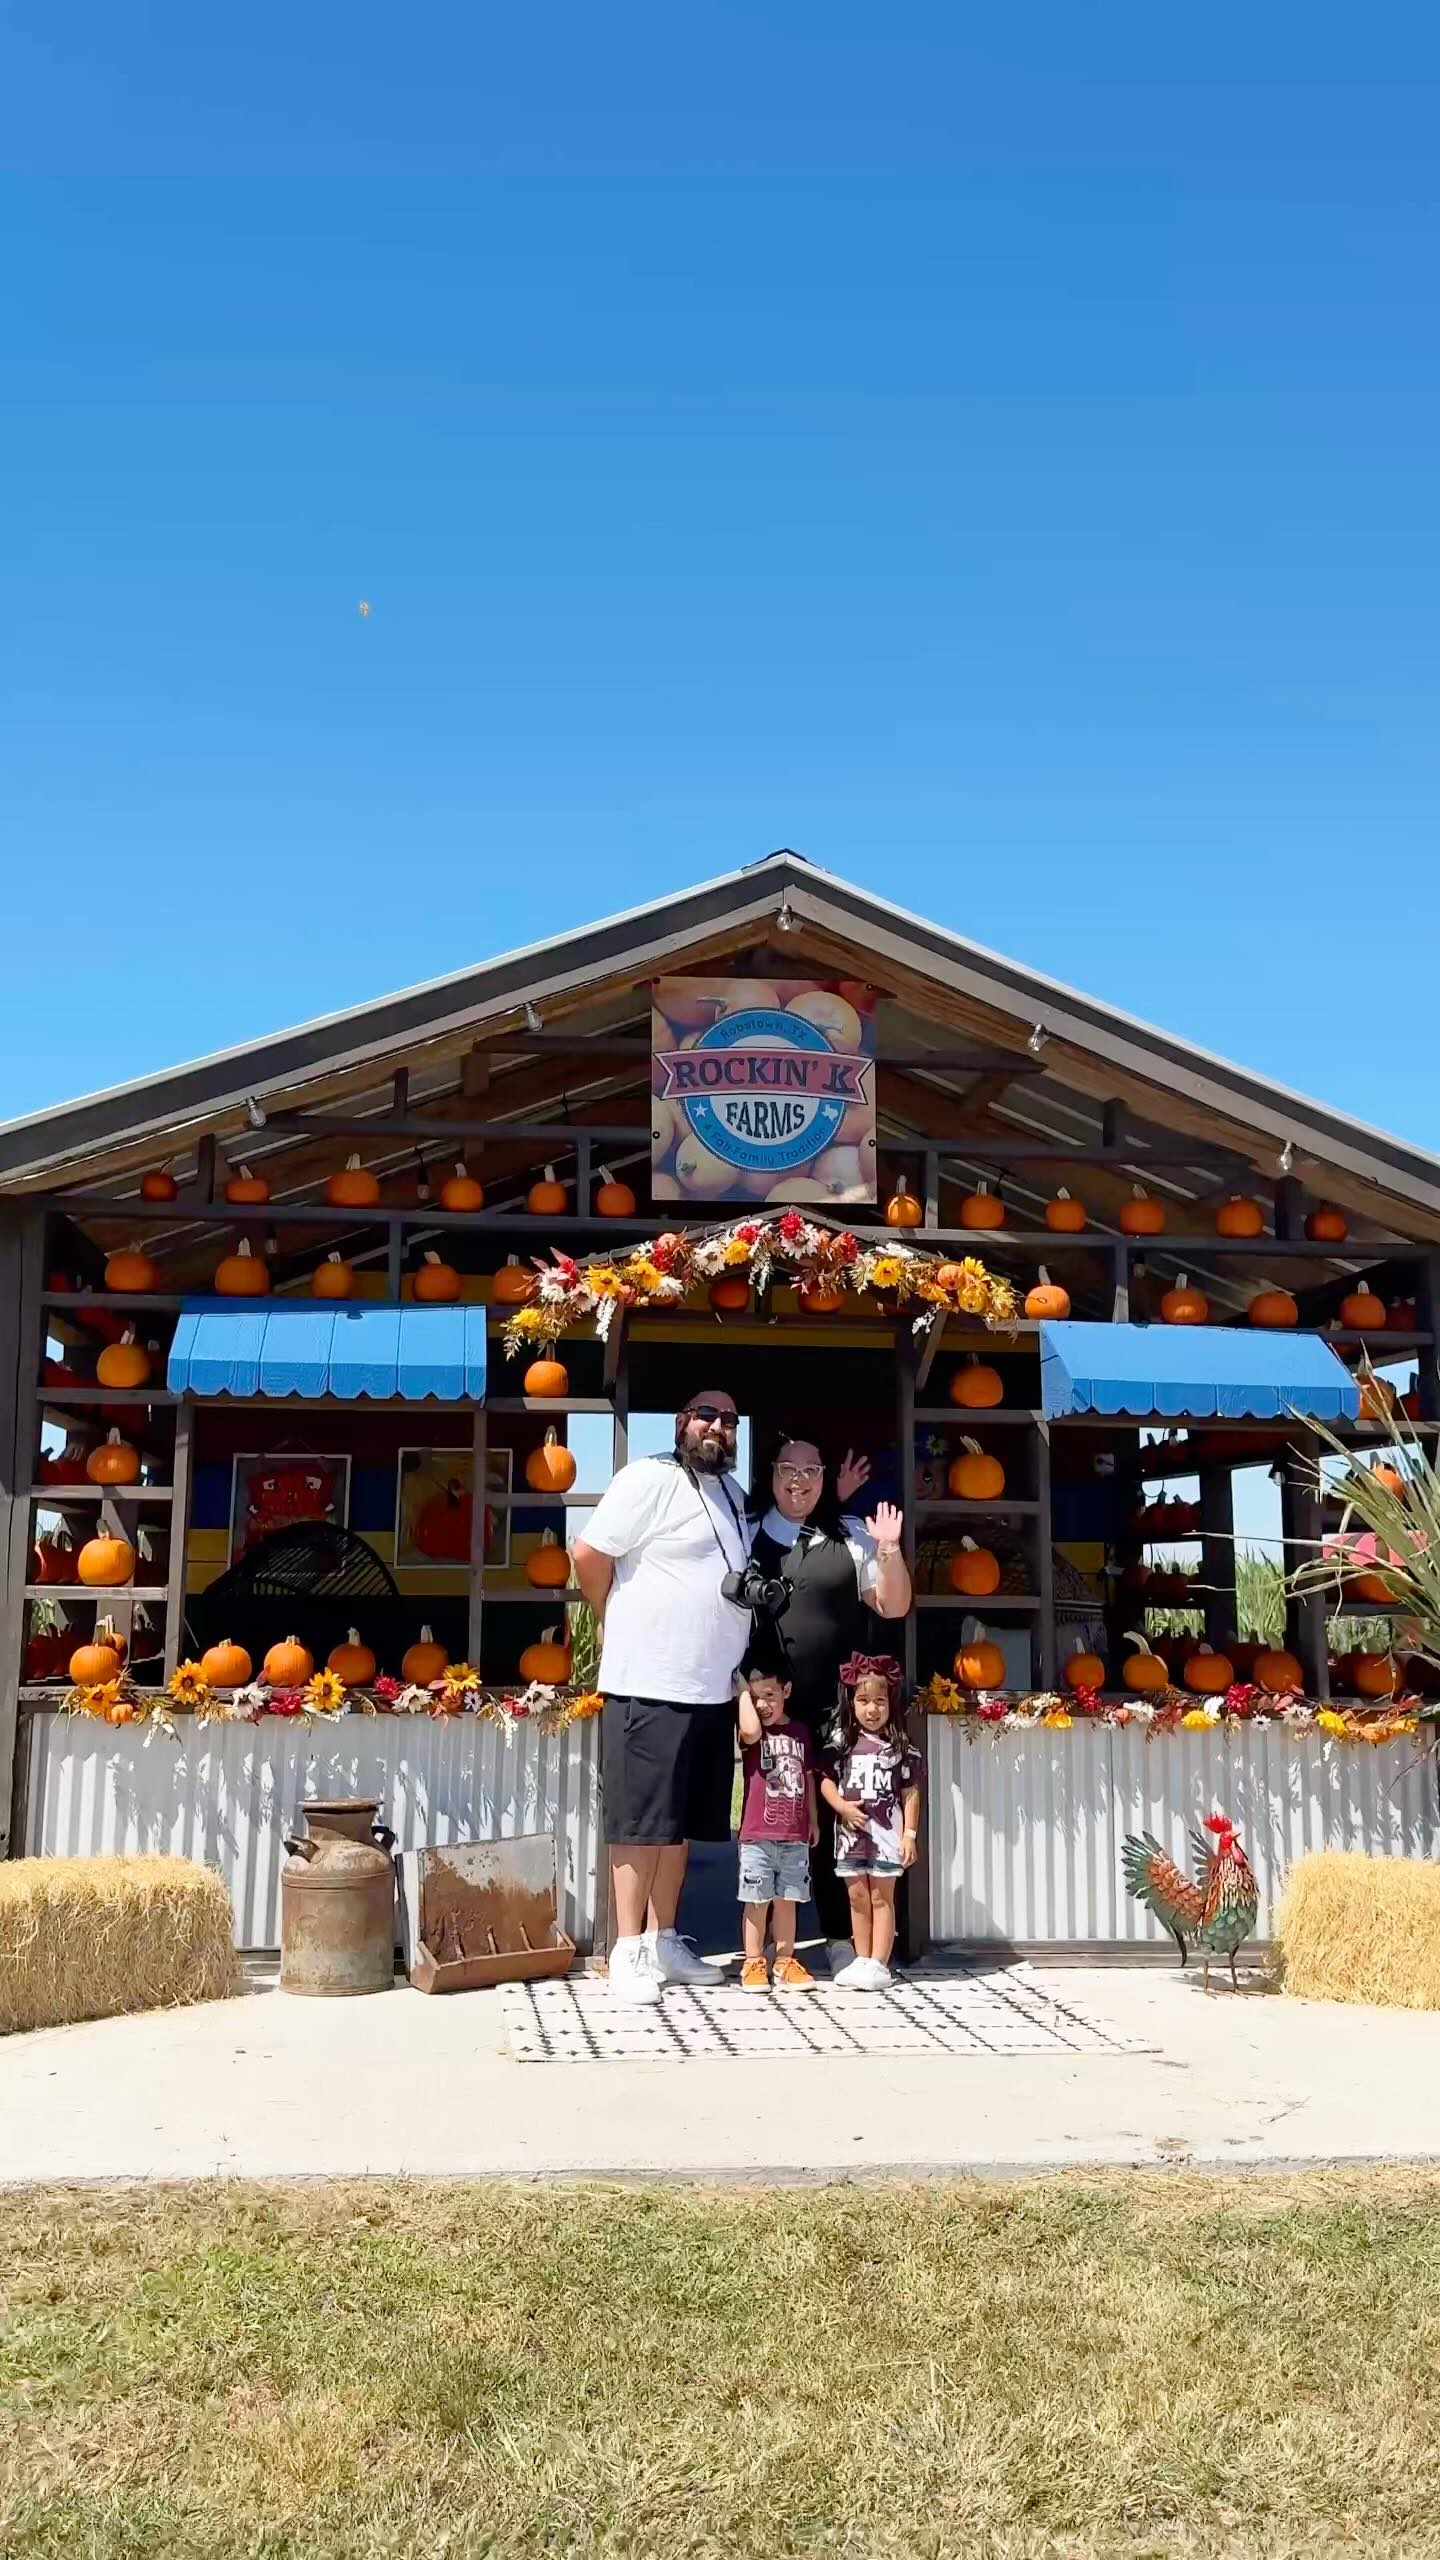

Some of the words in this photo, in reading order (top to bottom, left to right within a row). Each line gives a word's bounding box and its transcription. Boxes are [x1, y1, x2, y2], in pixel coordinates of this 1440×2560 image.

[792, 1022, 808, 1041] TX
[673, 1056, 819, 1088] ROCKIN'
[822, 1063, 856, 1094] K
[726, 1101, 805, 1139] FARMS
[732, 1146, 774, 1165] Family
[779, 1127, 825, 1161] Tradition
